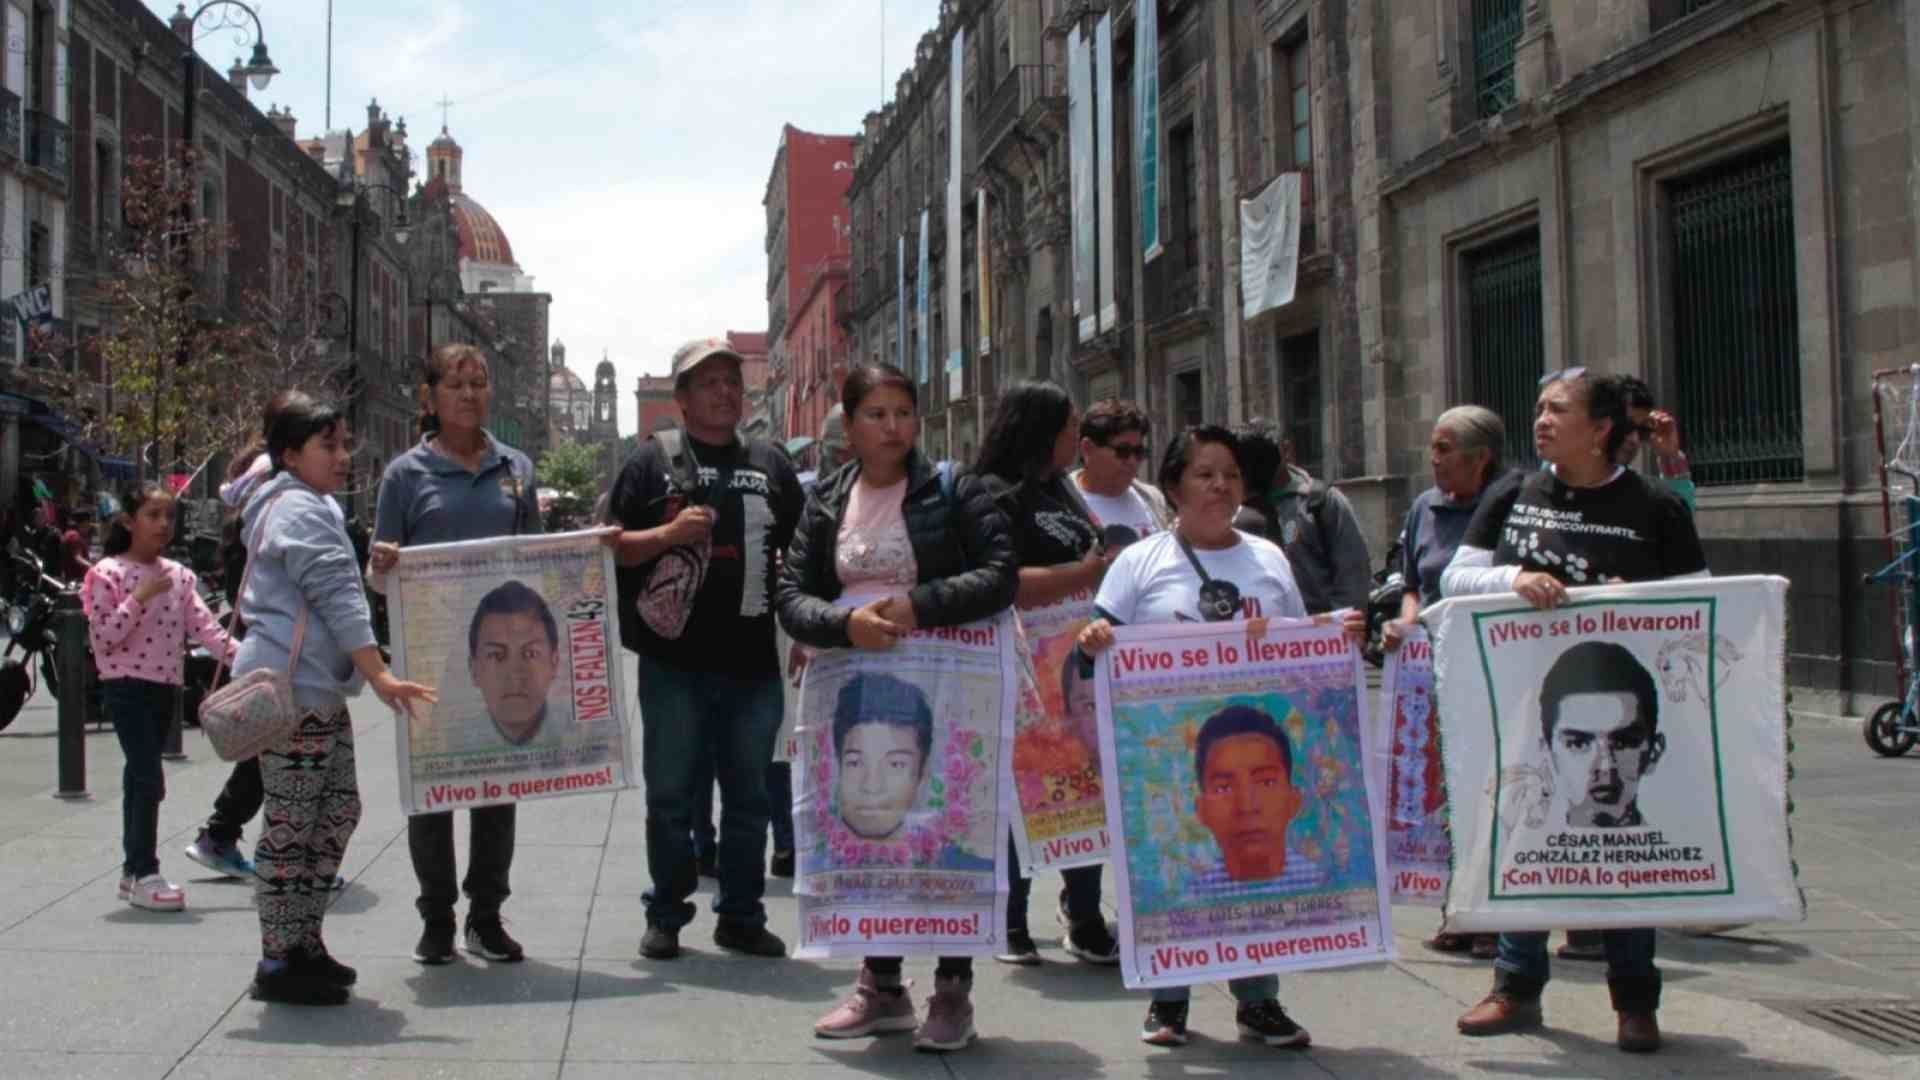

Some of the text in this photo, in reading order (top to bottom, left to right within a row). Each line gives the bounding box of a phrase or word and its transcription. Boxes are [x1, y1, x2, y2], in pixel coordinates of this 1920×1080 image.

[1489, 609, 1701, 648] ¡Vivo se lo llevaron!
[573, 621, 607, 681] FALTAN
[1113, 648, 1174, 680] ¡Vivo
[1181, 647, 1209, 669] se
[1216, 641, 1238, 665] lo
[1246, 631, 1350, 663] llevaron!
[574, 684, 609, 720] NOS
[425, 766, 613, 809] ¡Vivo lo queremos!
[1043, 836, 1094, 865] ¡Vivo
[1514, 846, 1704, 865] GONZÁLEZ HERNÁNDEZ
[1546, 831, 1669, 848] CÉSAR MANUEL
[1393, 871, 1441, 894] ¡Vivo
[1502, 864, 1716, 890] ¡Con VIDA lo queremos!
[857, 914, 979, 940] queremos!
[1150, 947, 1210, 977] ¡Vivo
[1216, 941, 1239, 964] lo
[1247, 925, 1369, 965] queremos!
